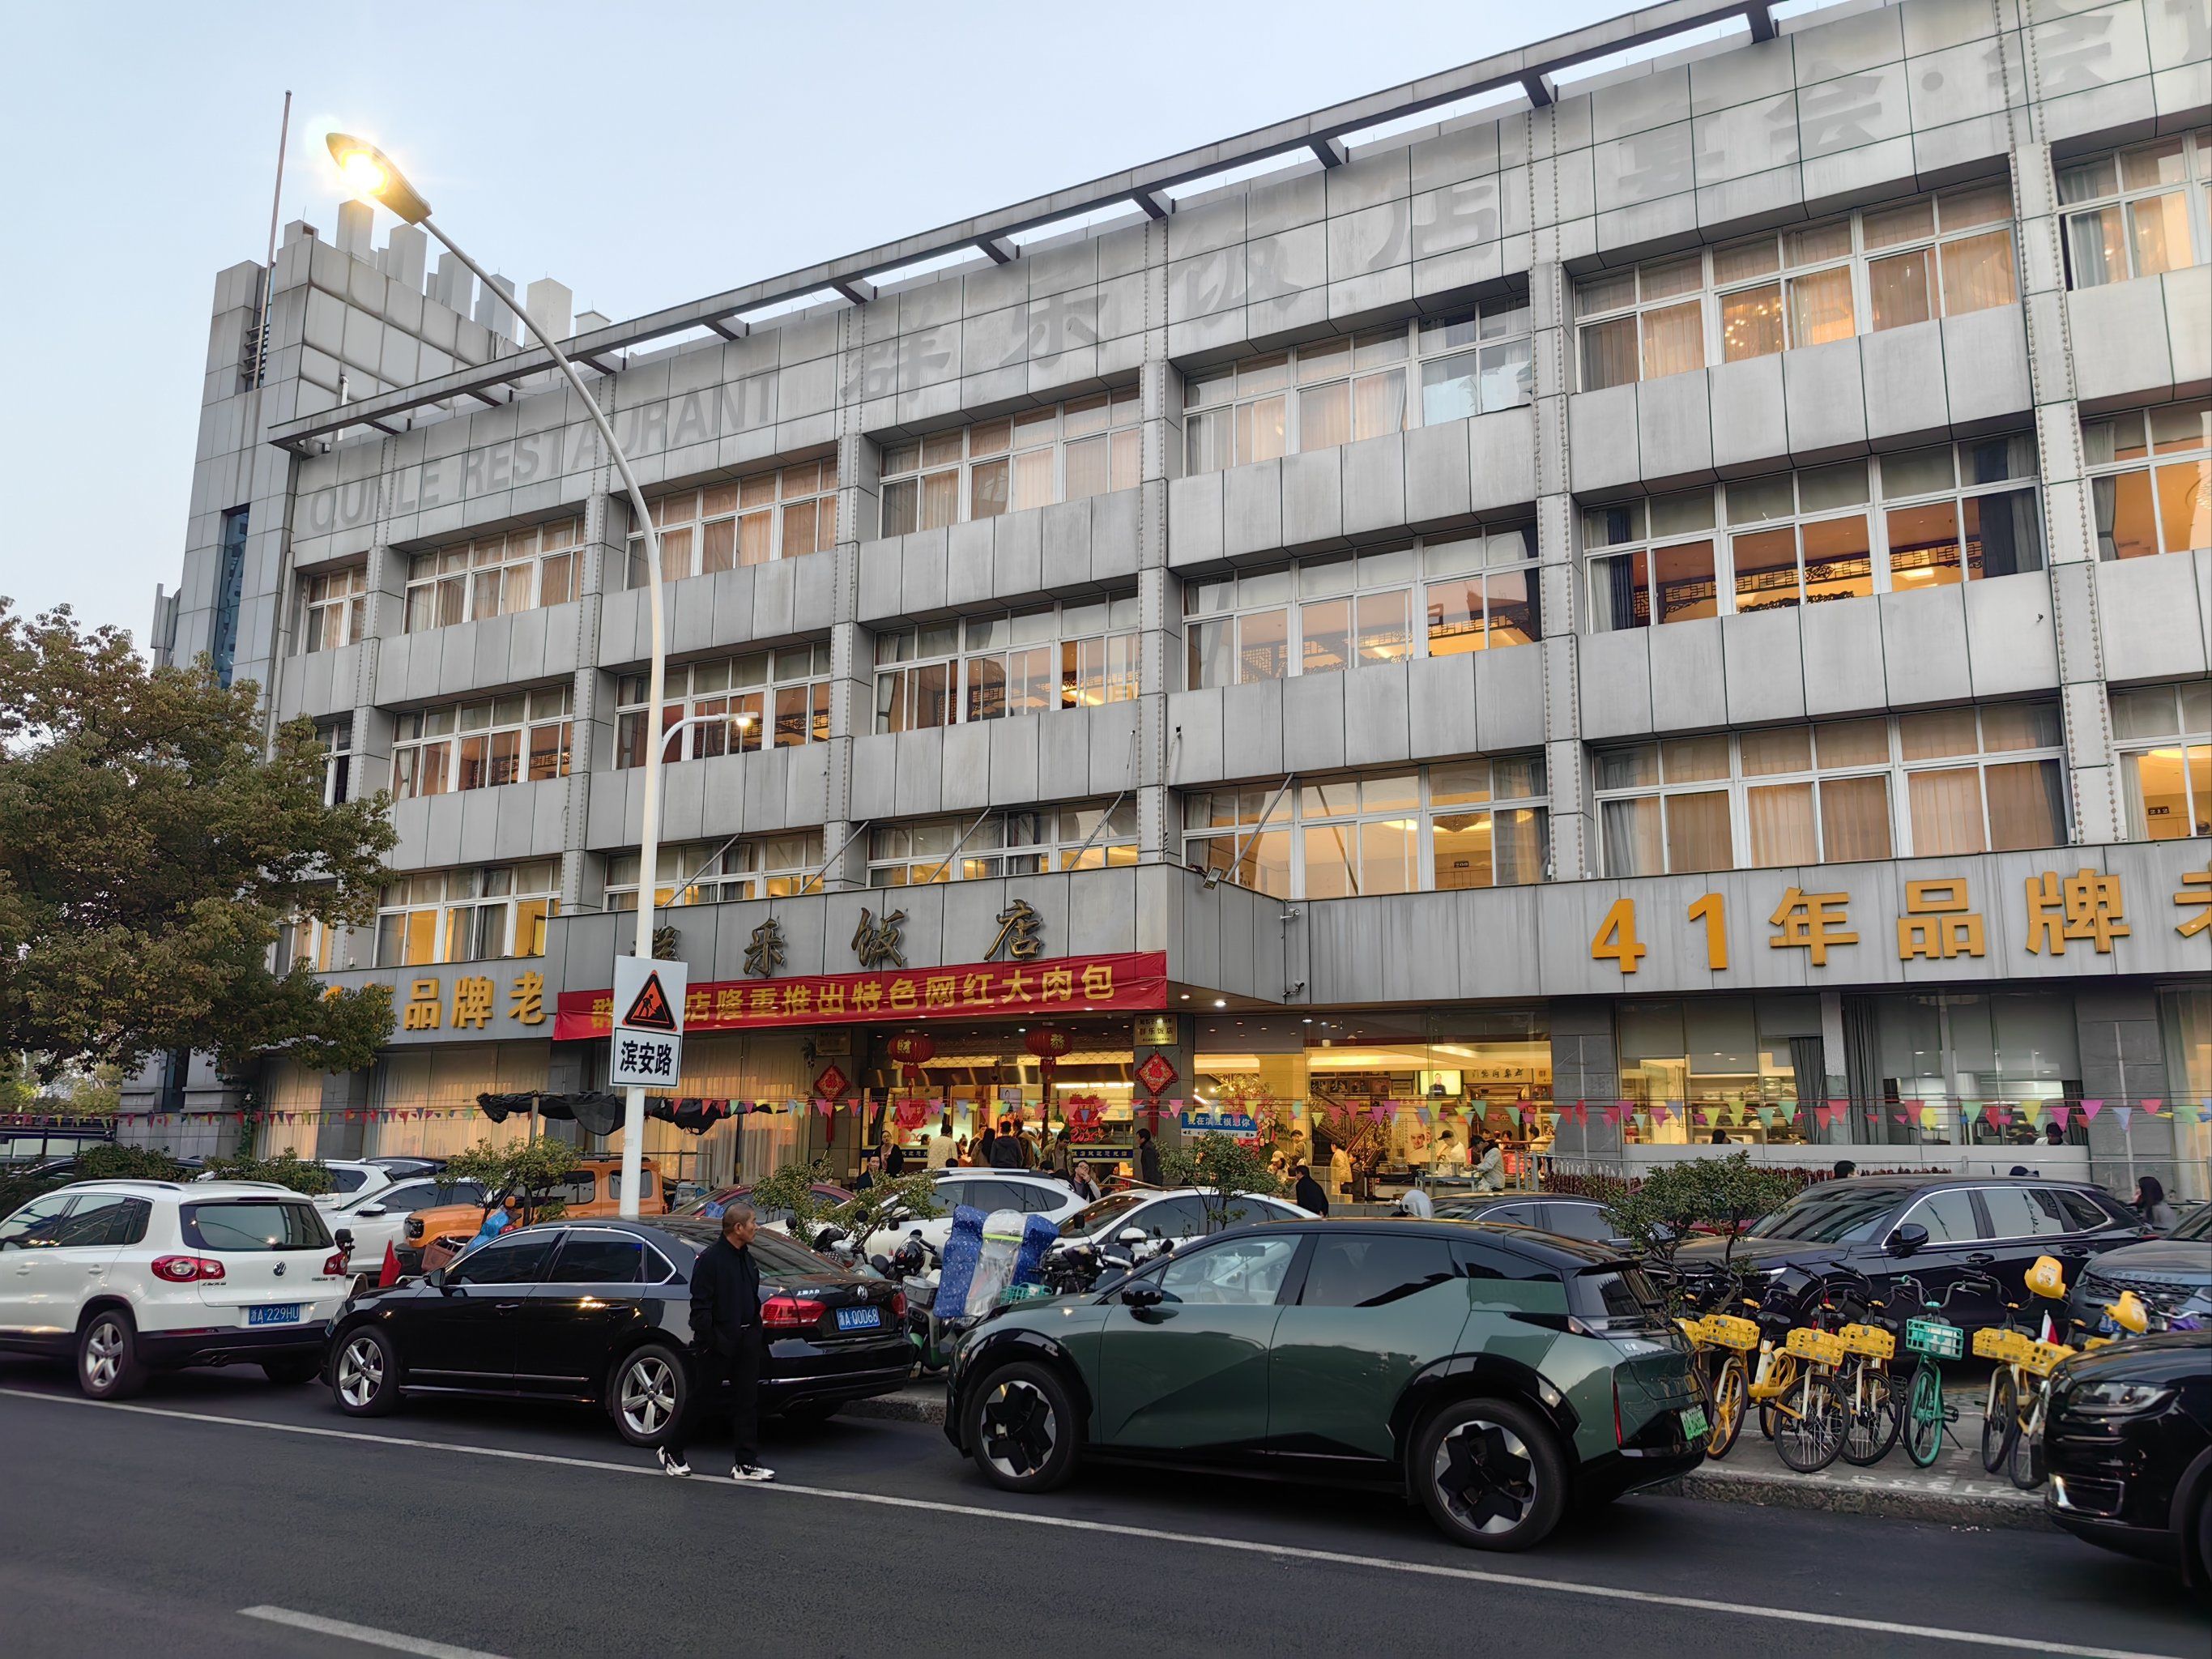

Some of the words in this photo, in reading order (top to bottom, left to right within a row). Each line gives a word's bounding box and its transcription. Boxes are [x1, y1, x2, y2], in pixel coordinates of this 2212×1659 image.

[458, 369, 779, 498] RESTAURANT
[324, 971, 546, 1030] 品牌老
[592, 963, 1115, 1029] 群店隆重推出特色网红大肉包
[620, 1040, 672, 1076] 滨安路
